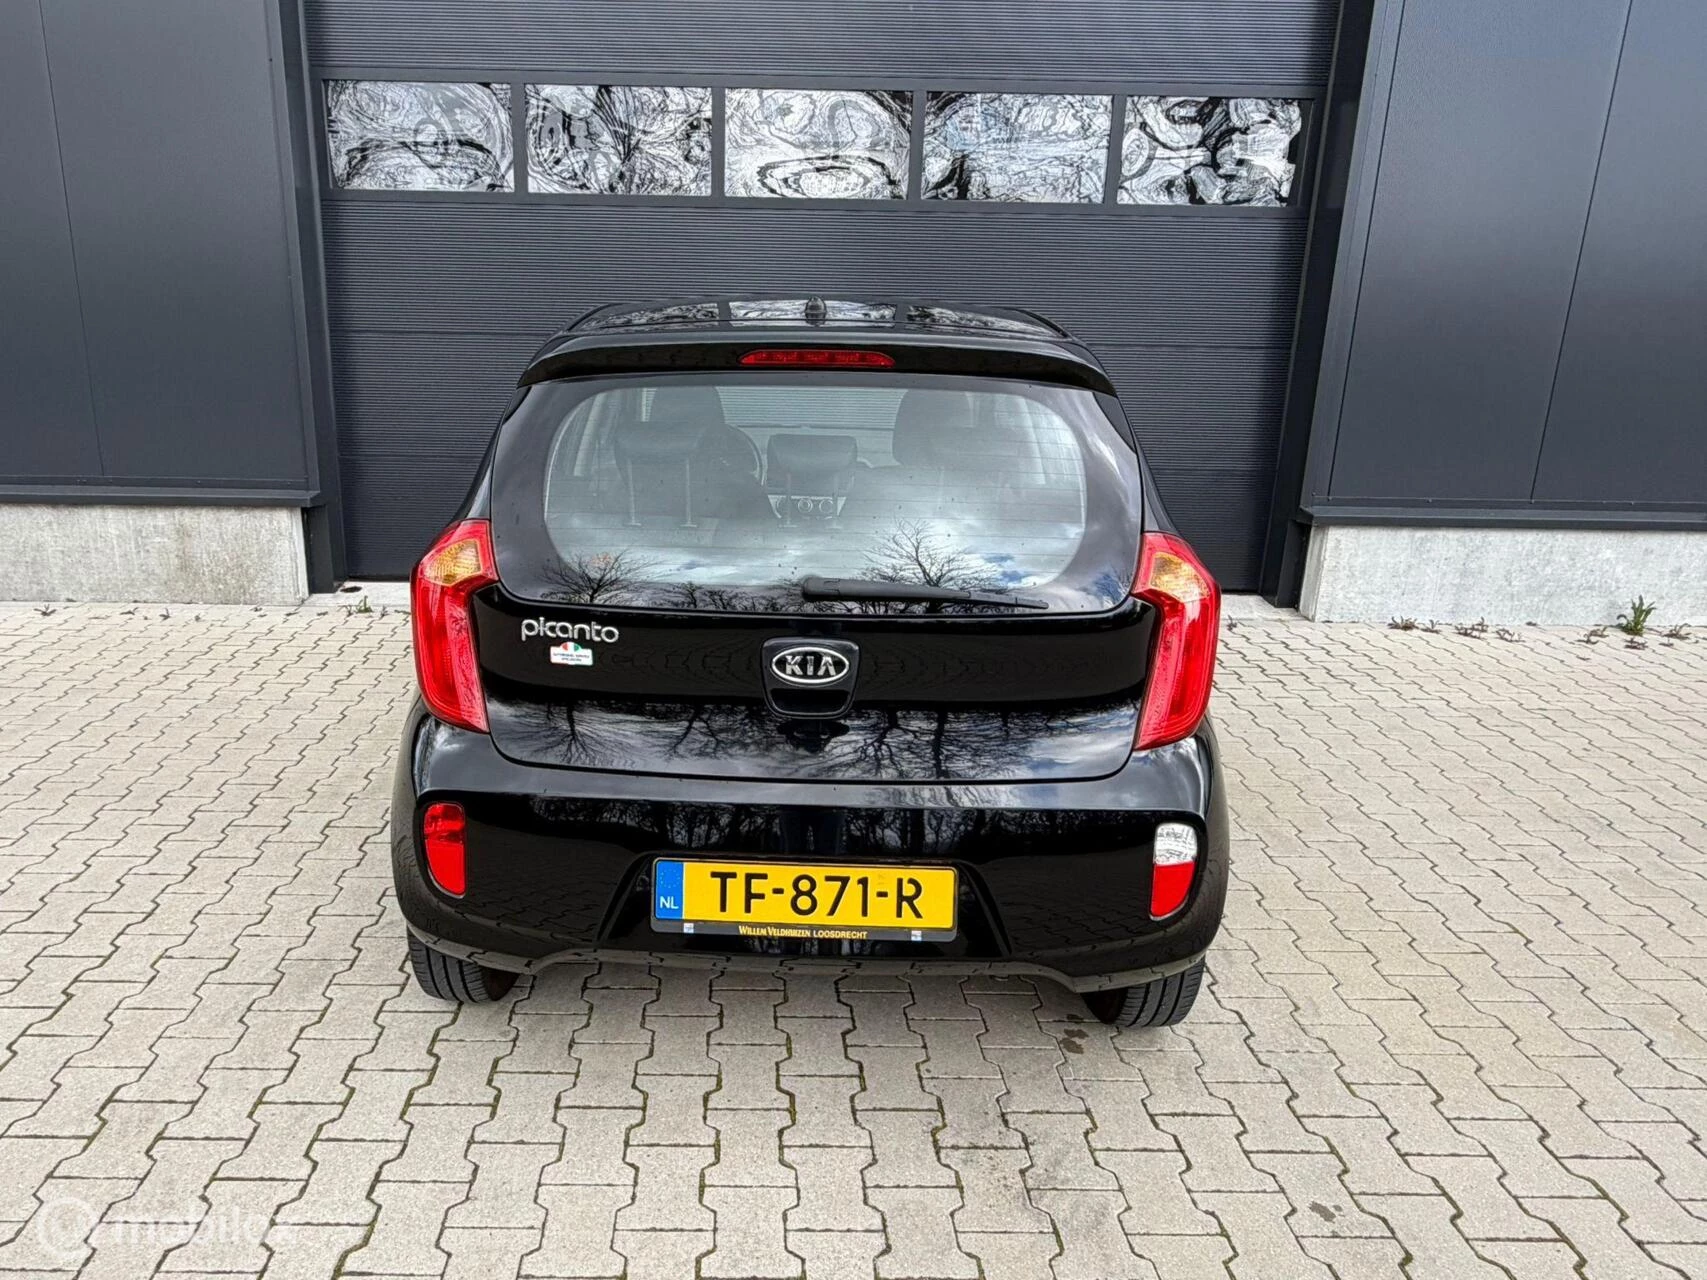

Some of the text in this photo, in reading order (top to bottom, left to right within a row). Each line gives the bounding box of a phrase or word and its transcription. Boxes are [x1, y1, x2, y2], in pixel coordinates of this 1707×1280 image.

[521, 616, 619, 643] picanto
[785, 655, 837, 676] KIA
[659, 895, 680, 910] NL
[710, 870, 924, 919] TF-871-R
[813, 929, 868, 939] LOOSDRECHT
